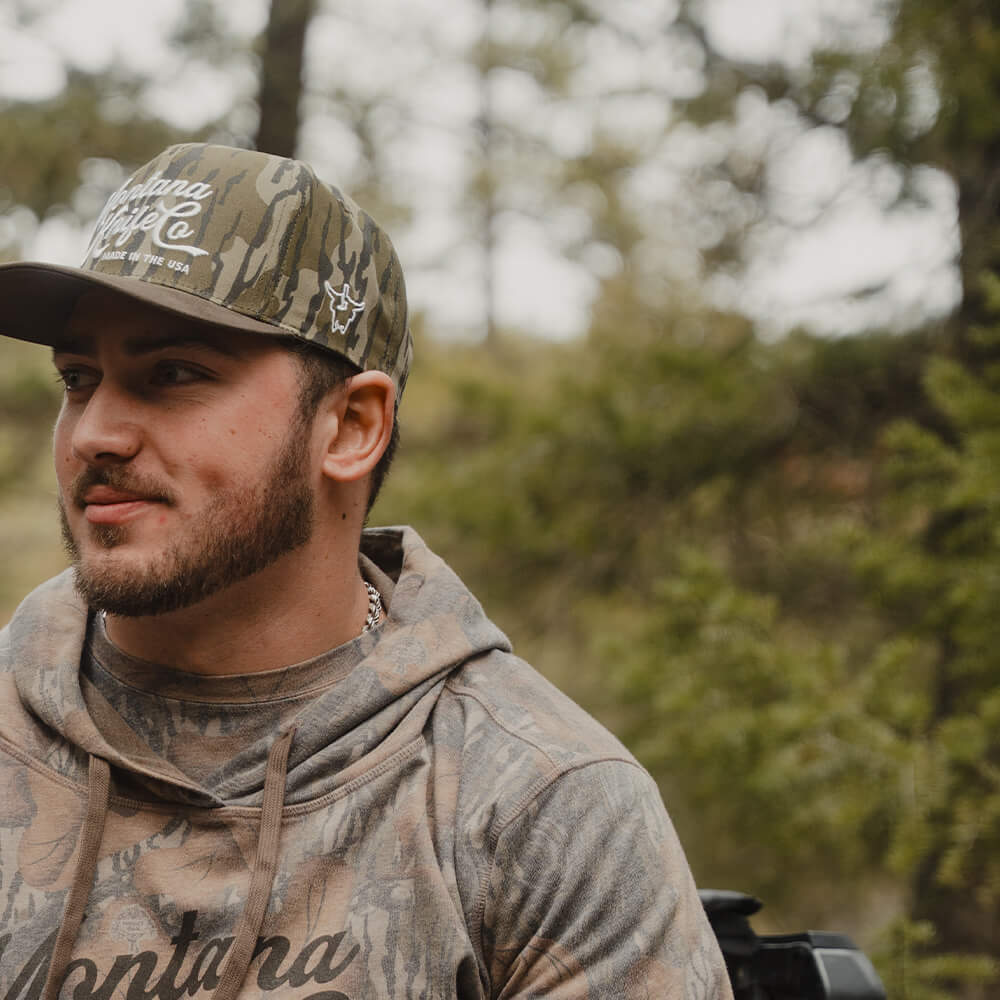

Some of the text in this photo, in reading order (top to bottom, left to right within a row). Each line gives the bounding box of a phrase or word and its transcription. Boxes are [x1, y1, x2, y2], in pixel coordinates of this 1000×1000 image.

[128, 251, 141, 262] IN
[143, 253, 165, 266] THE
[167, 260, 190, 275] USA
